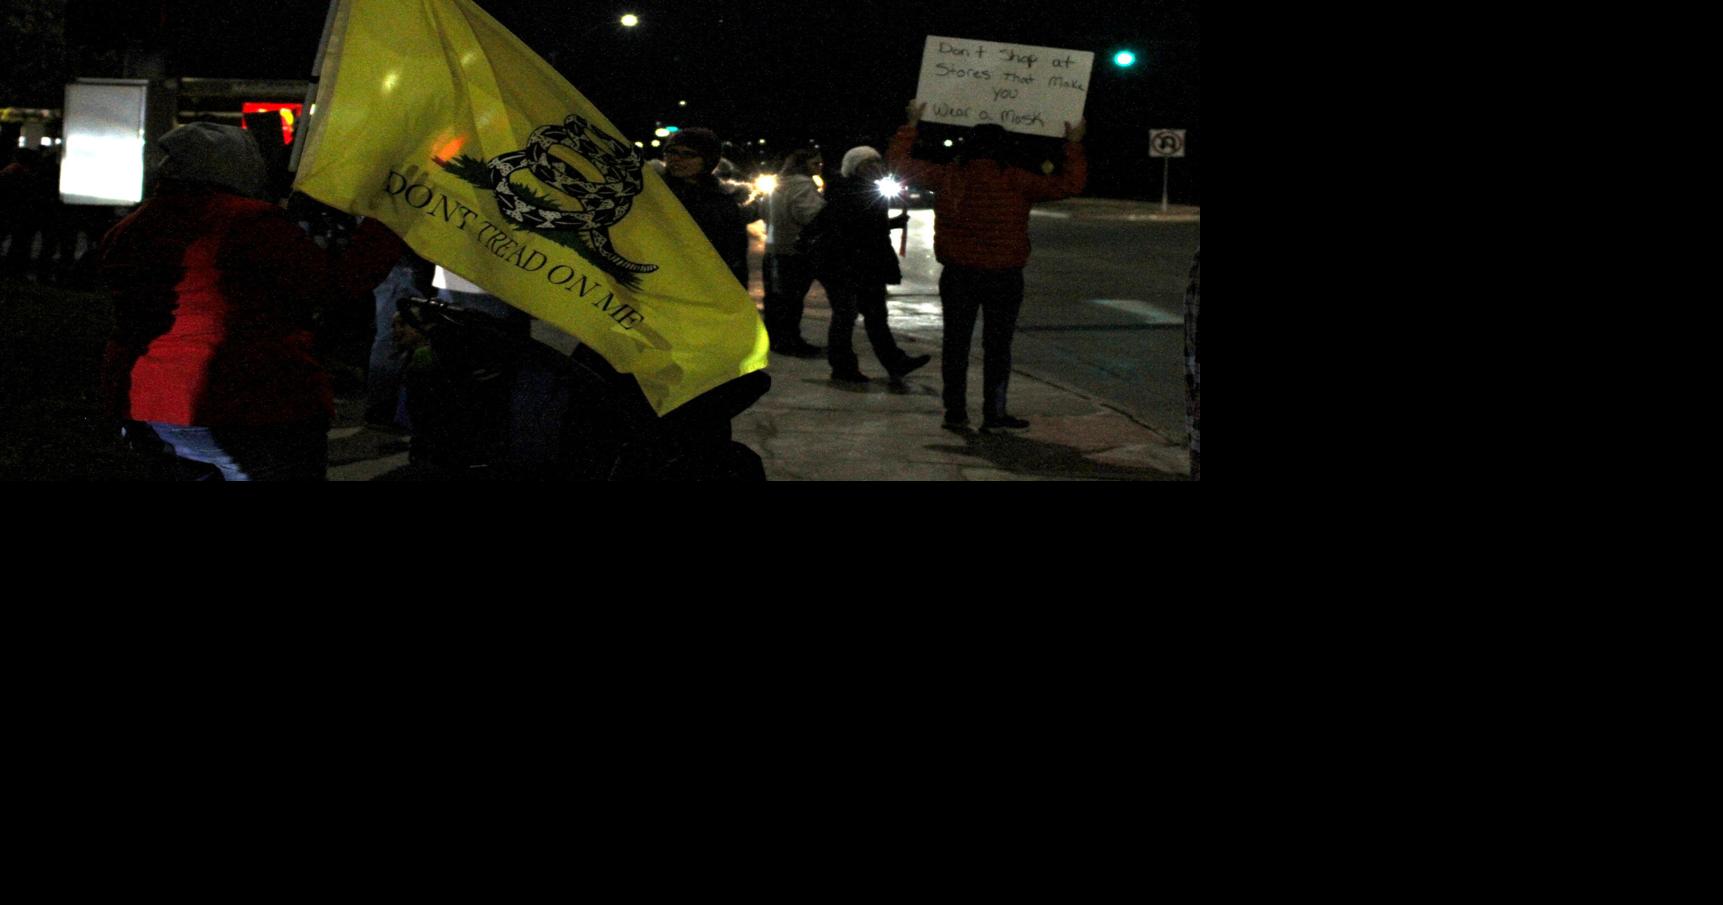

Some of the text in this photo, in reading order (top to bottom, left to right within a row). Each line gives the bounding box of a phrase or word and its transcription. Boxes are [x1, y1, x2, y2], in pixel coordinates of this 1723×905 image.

[1000, 49, 1038, 68] Shop
[1052, 55, 1075, 68] at
[935, 63, 991, 80] Stores
[933, 103, 1044, 127] Wear a Mask
[476, 221, 548, 272] TREAD
[547, 264, 600, 298] ON
[593, 290, 645, 330] ME
